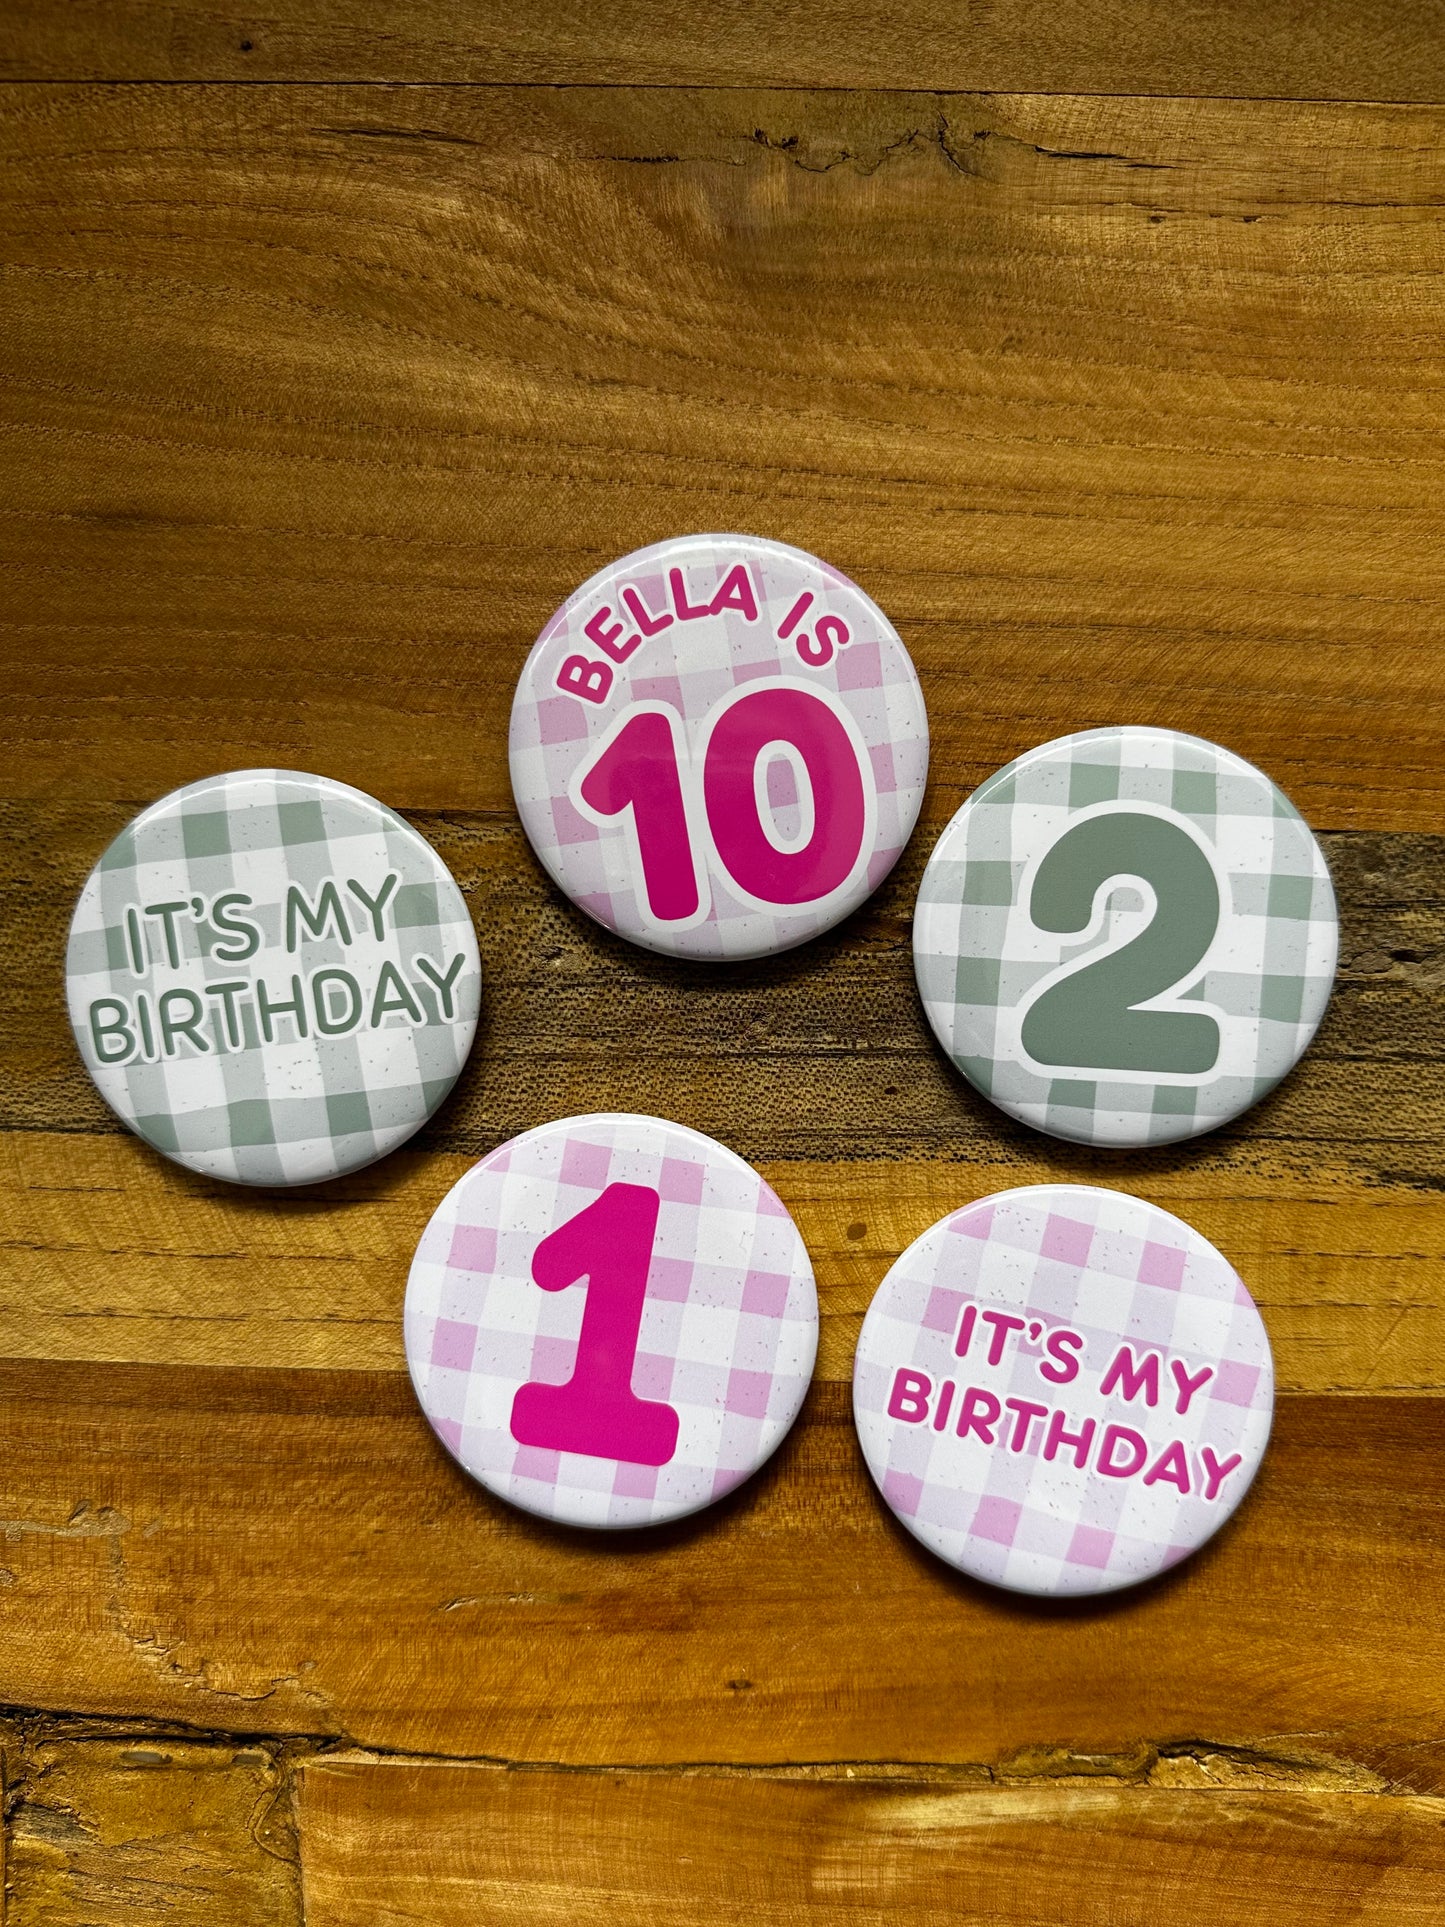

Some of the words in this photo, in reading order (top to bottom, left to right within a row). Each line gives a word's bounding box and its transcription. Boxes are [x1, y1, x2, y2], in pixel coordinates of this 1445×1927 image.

[556, 565, 758, 704] BELLA
[777, 592, 850, 667] IS
[580, 688, 866, 921] 10
[127, 893, 260, 974] IT'S
[286, 874, 398, 953] MY
[1022, 812, 1220, 1074] 2
[89, 953, 466, 1063] BIRTHDAY
[509, 1182, 680, 1467] 1
[954, 1305, 1084, 1384] IT'S
[1100, 1346, 1213, 1415] MY
[887, 1367, 1242, 1500] BIRTHDAY
